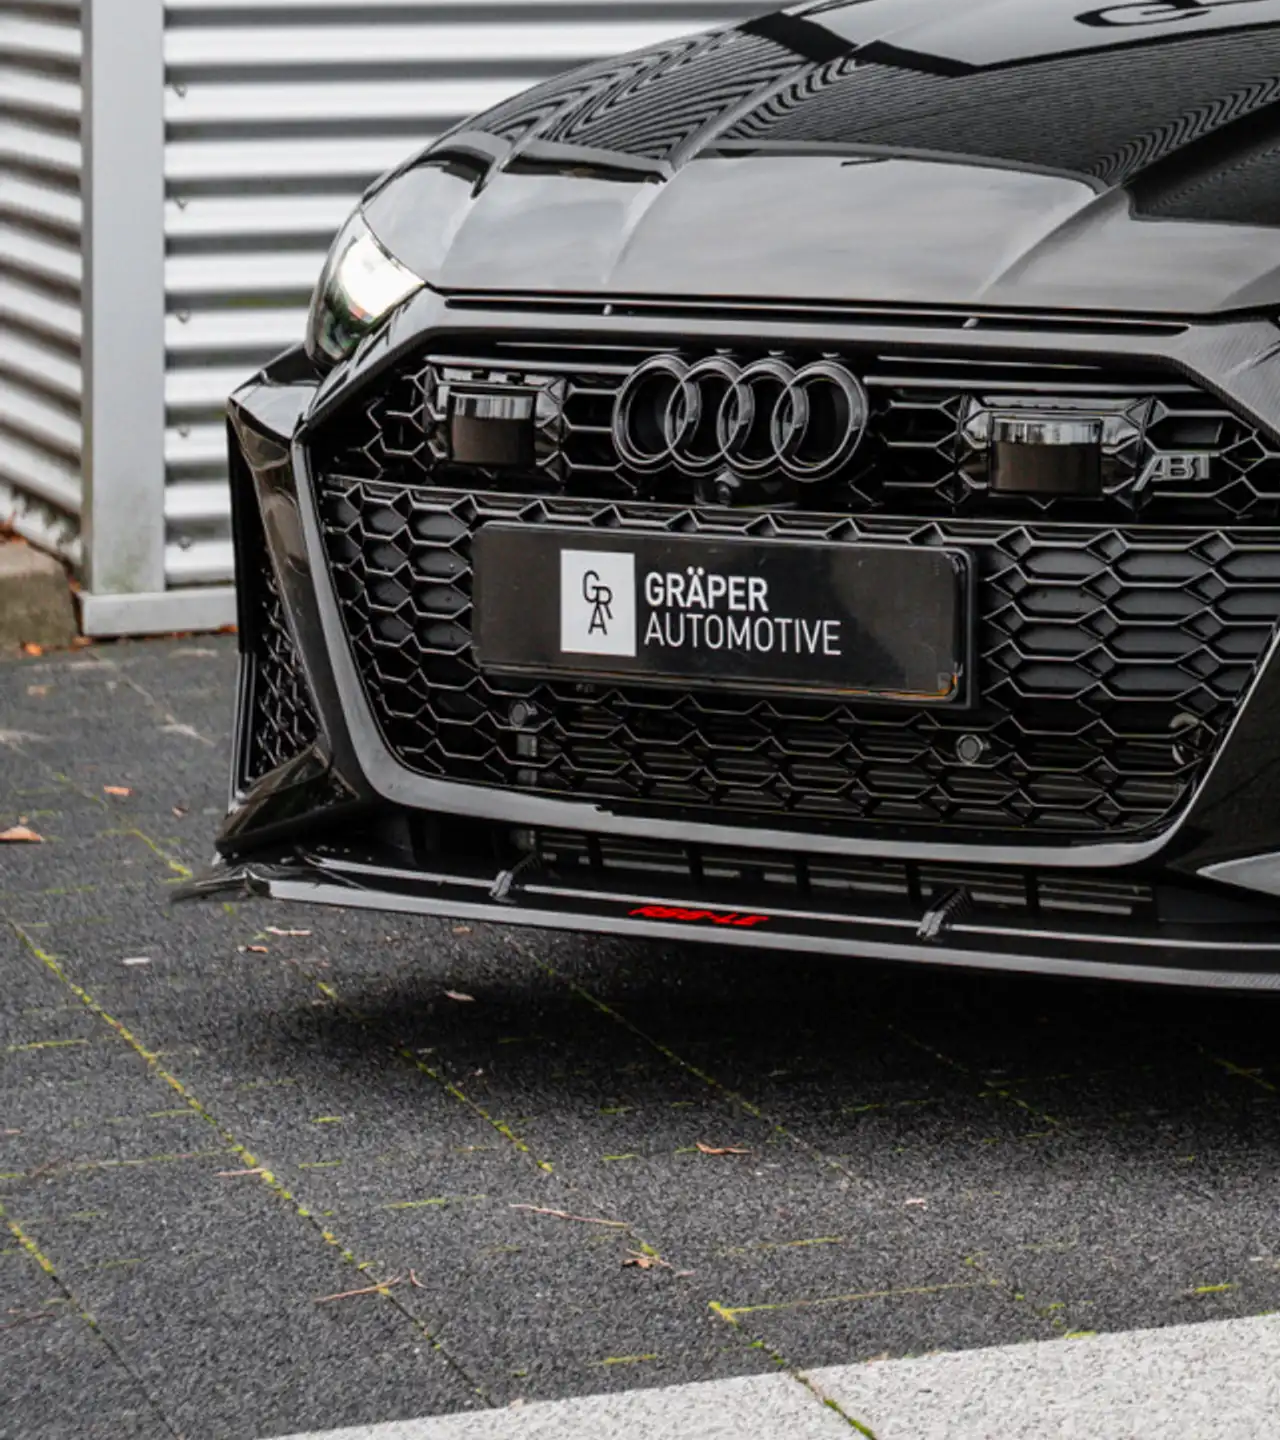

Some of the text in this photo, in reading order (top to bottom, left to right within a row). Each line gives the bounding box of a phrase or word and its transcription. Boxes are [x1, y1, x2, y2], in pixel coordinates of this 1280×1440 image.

[1131, 451, 1219, 492] ABT
[582, 569, 613, 636] GRA
[644, 565, 770, 612] GRÄPER
[643, 610, 842, 656] AUTOMOTIVE
